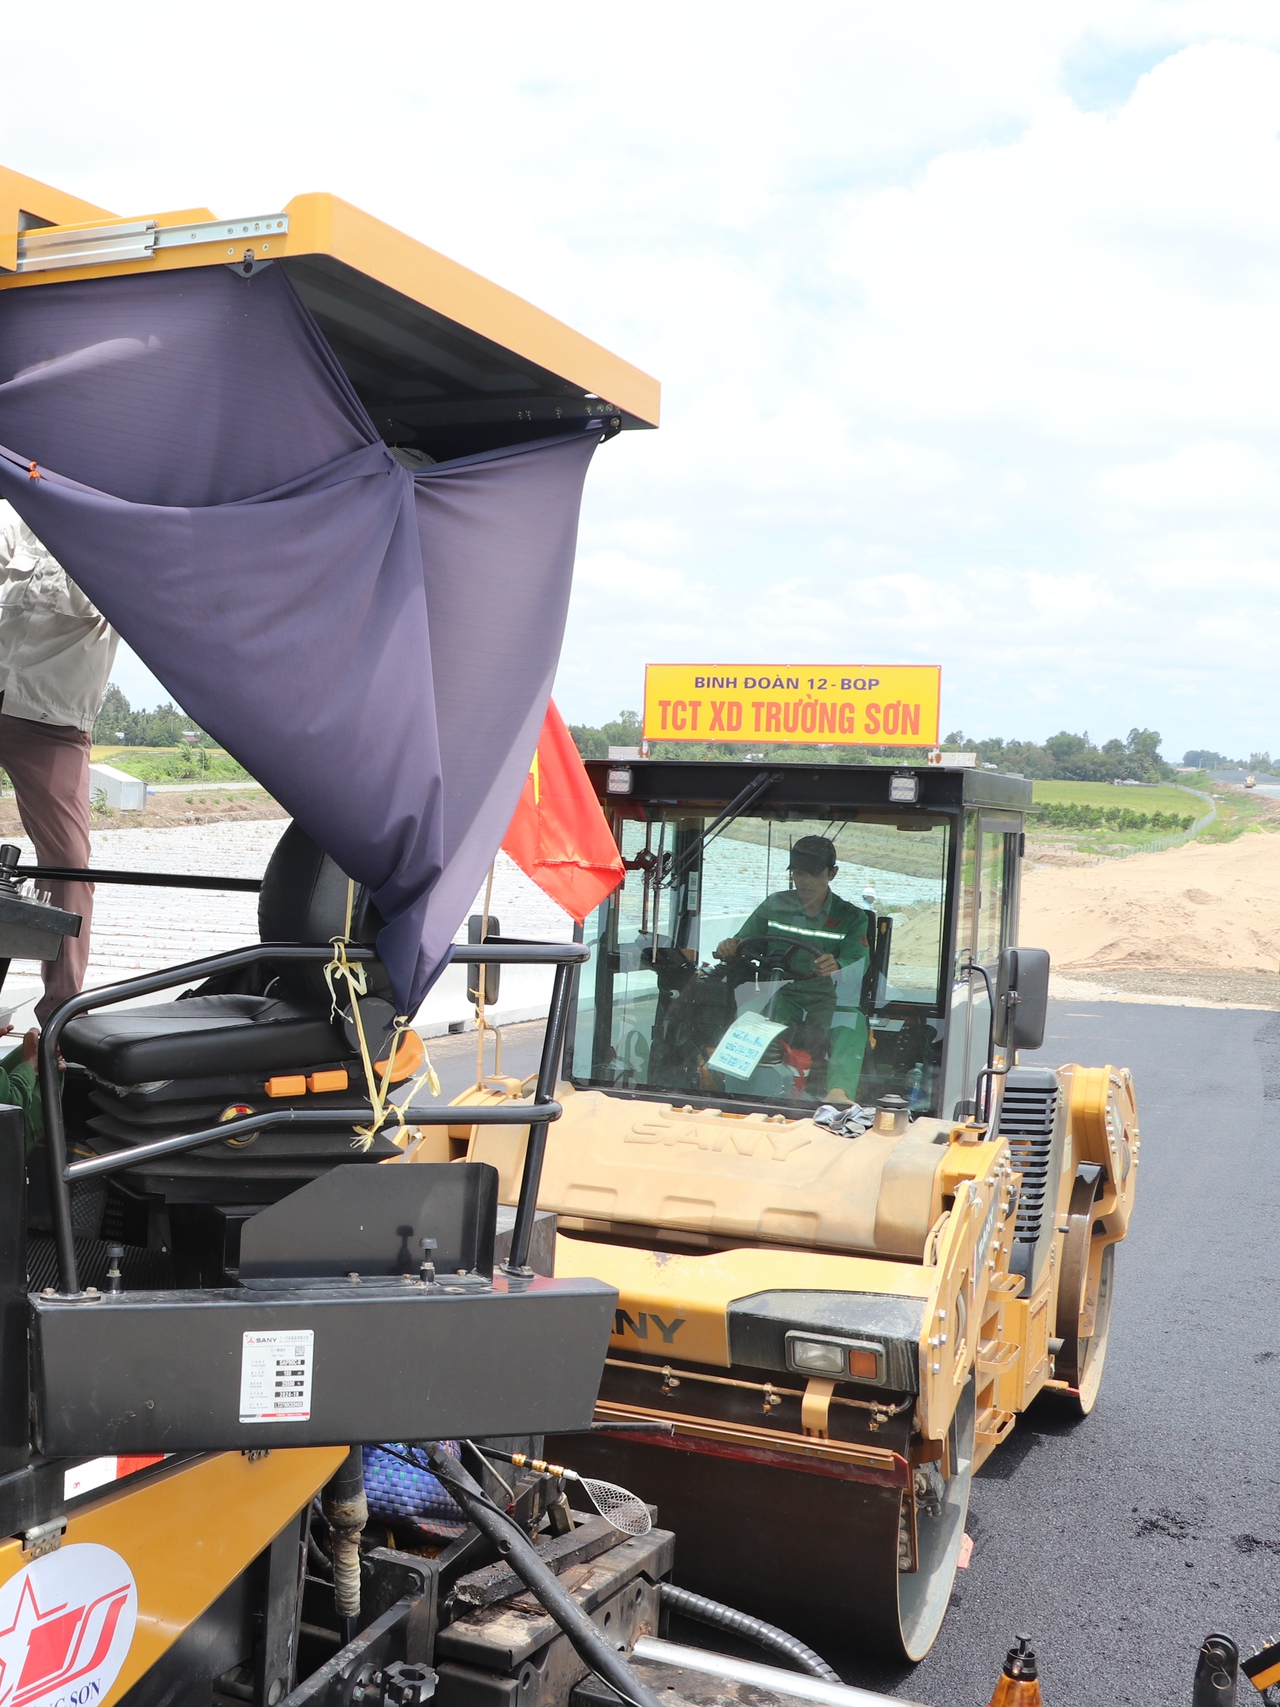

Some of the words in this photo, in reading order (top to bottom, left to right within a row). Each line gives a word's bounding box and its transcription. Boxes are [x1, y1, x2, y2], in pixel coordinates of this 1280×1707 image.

[694, 676, 738, 689] BINH
[743, 674, 799, 690] ĐOÀN
[658, 700, 702, 731] TCT
[709, 701, 743, 732] XD
[752, 694, 855, 734] TRƯỜNG
[864, 700, 921, 735] SƠN
[624, 1118, 812, 1161] SANY
[612, 1308, 686, 1344] NY
